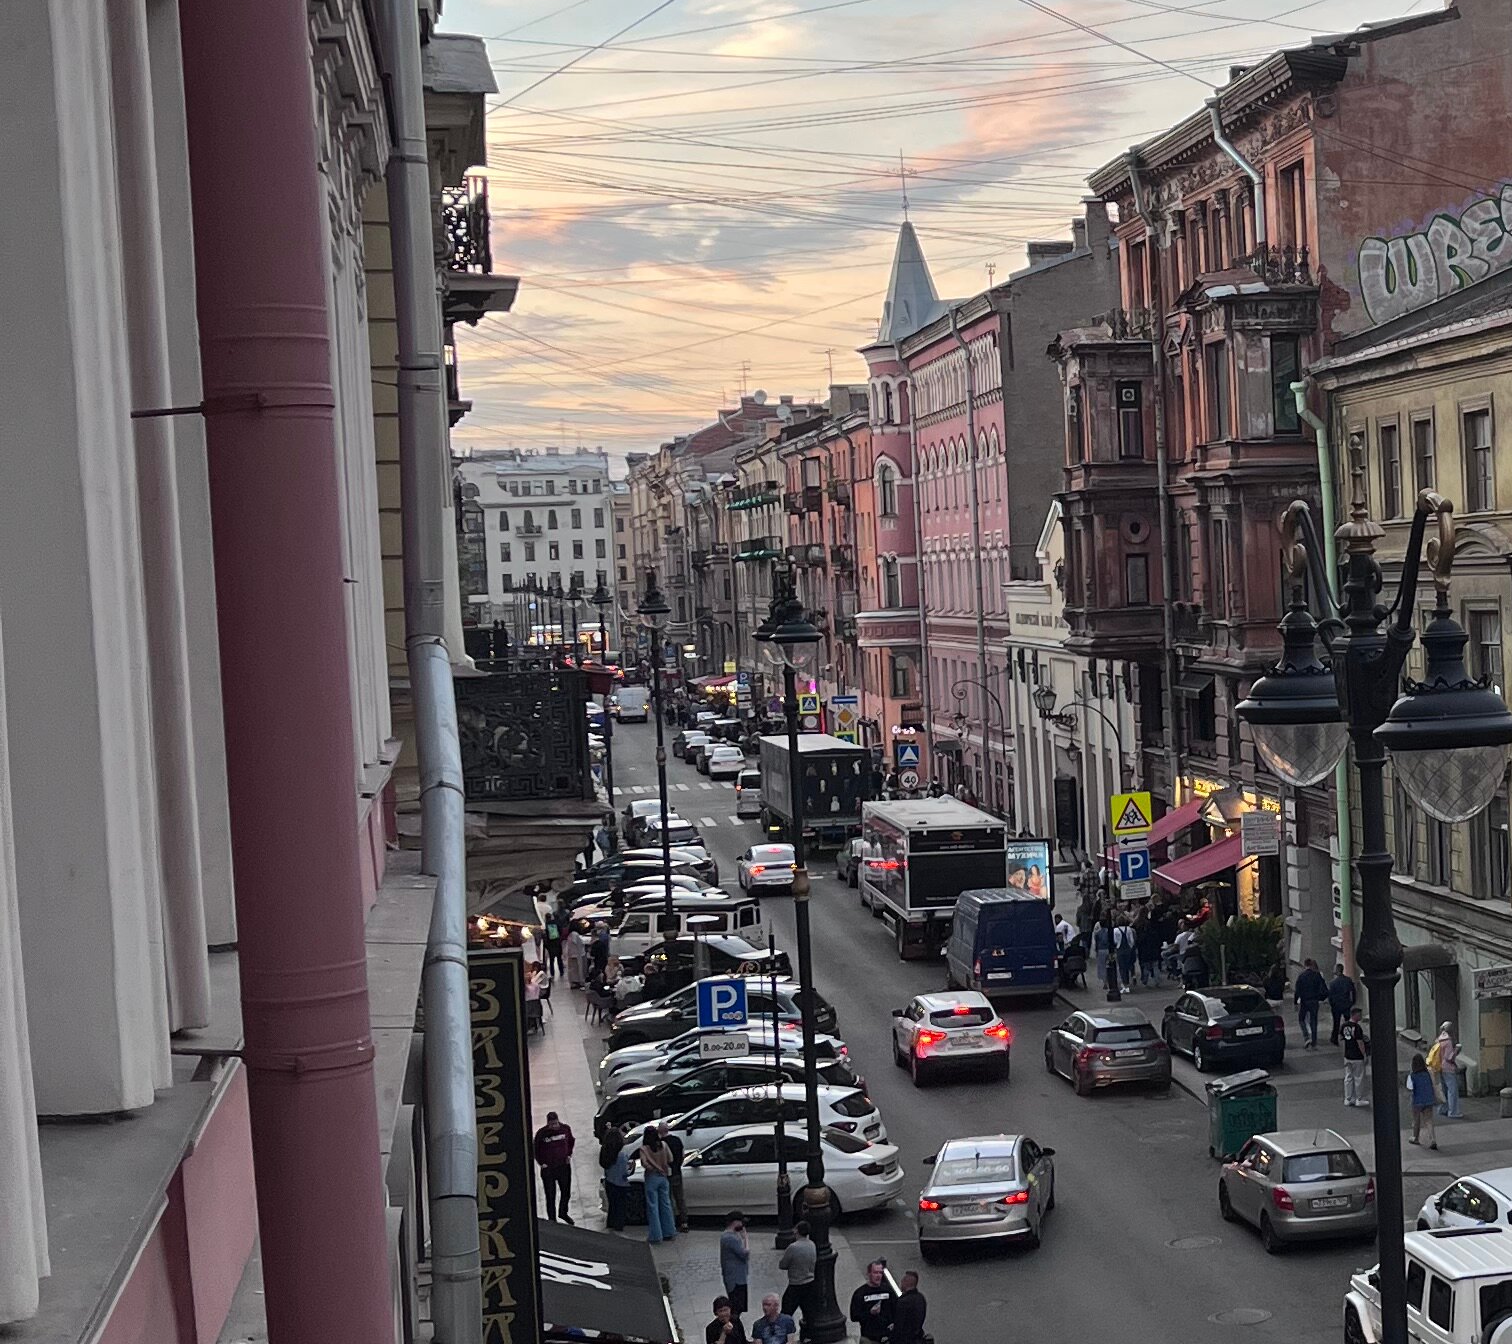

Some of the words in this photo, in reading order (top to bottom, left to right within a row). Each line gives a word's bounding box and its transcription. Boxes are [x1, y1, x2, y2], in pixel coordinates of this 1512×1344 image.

[904, 775, 916, 785] 40
[1127, 854, 1144, 878] P
[711, 984, 738, 1022] P
